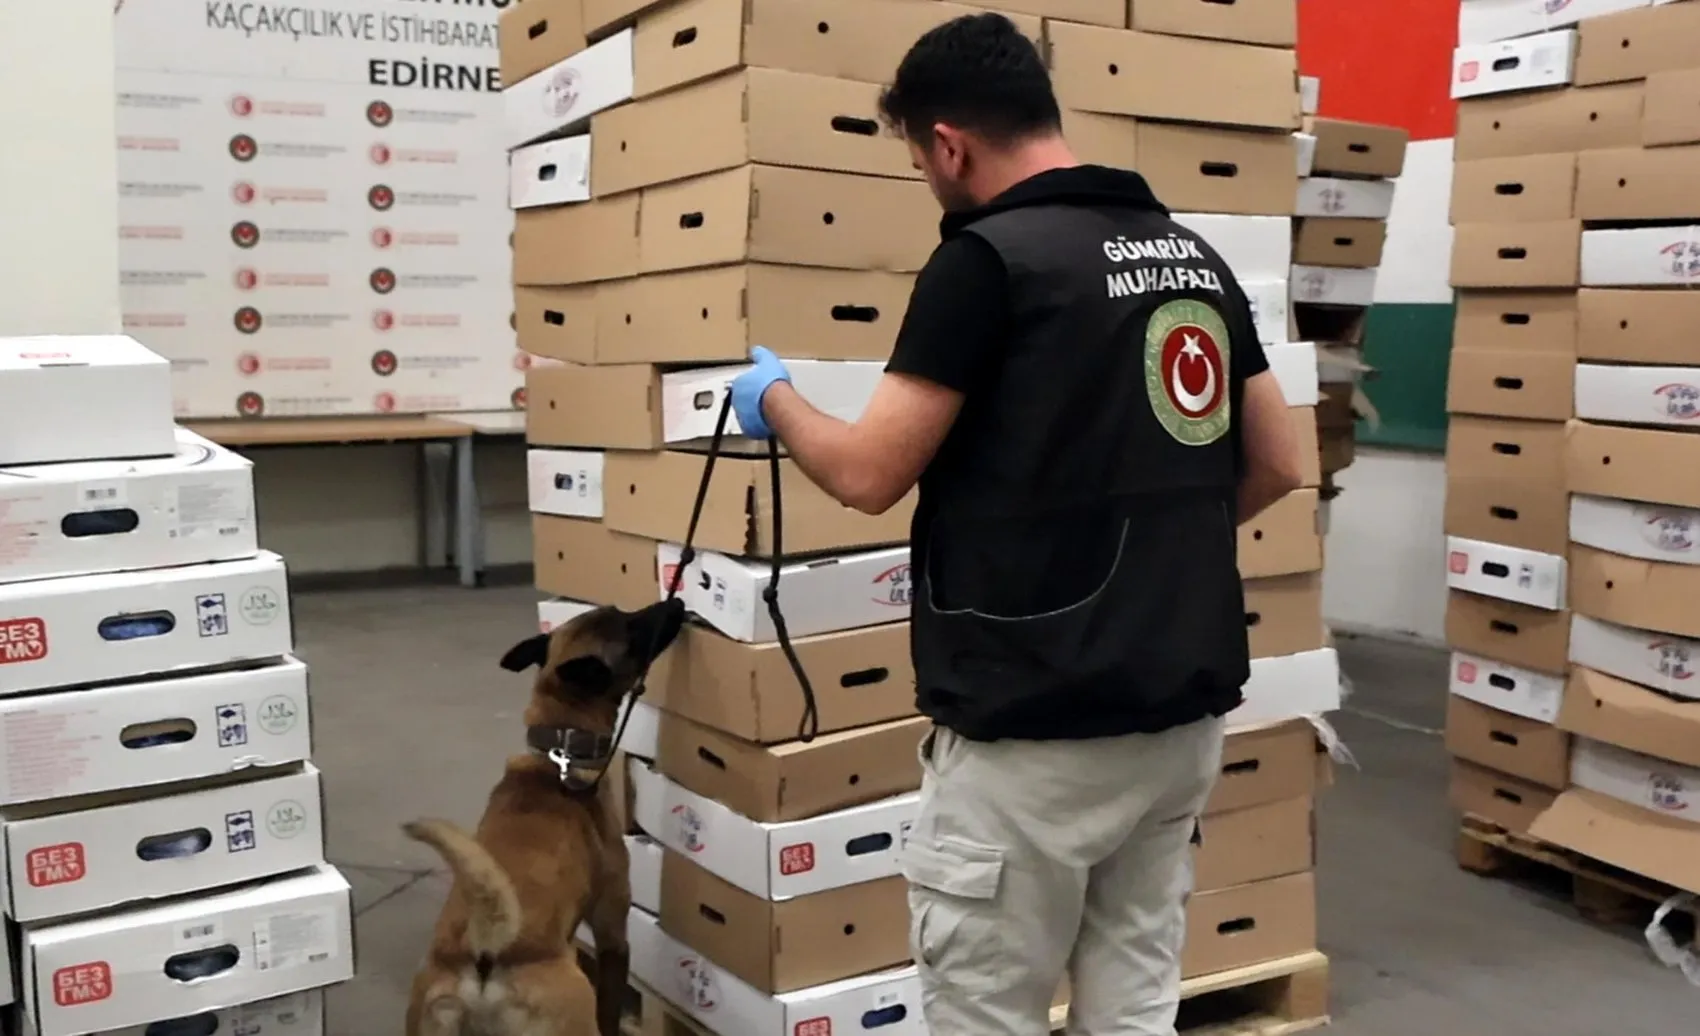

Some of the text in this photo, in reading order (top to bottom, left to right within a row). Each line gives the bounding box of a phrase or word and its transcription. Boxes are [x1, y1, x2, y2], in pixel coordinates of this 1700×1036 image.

[206, 2, 344, 42] KAÇAKÇILIK
[347, 12, 376, 41] VE
[368, 56, 502, 93] EDİRNE
[1103, 233, 1205, 263] GÜMRÜK
[31, 847, 78, 869] БЕЗ
[58, 965, 105, 987] БЕЗ
